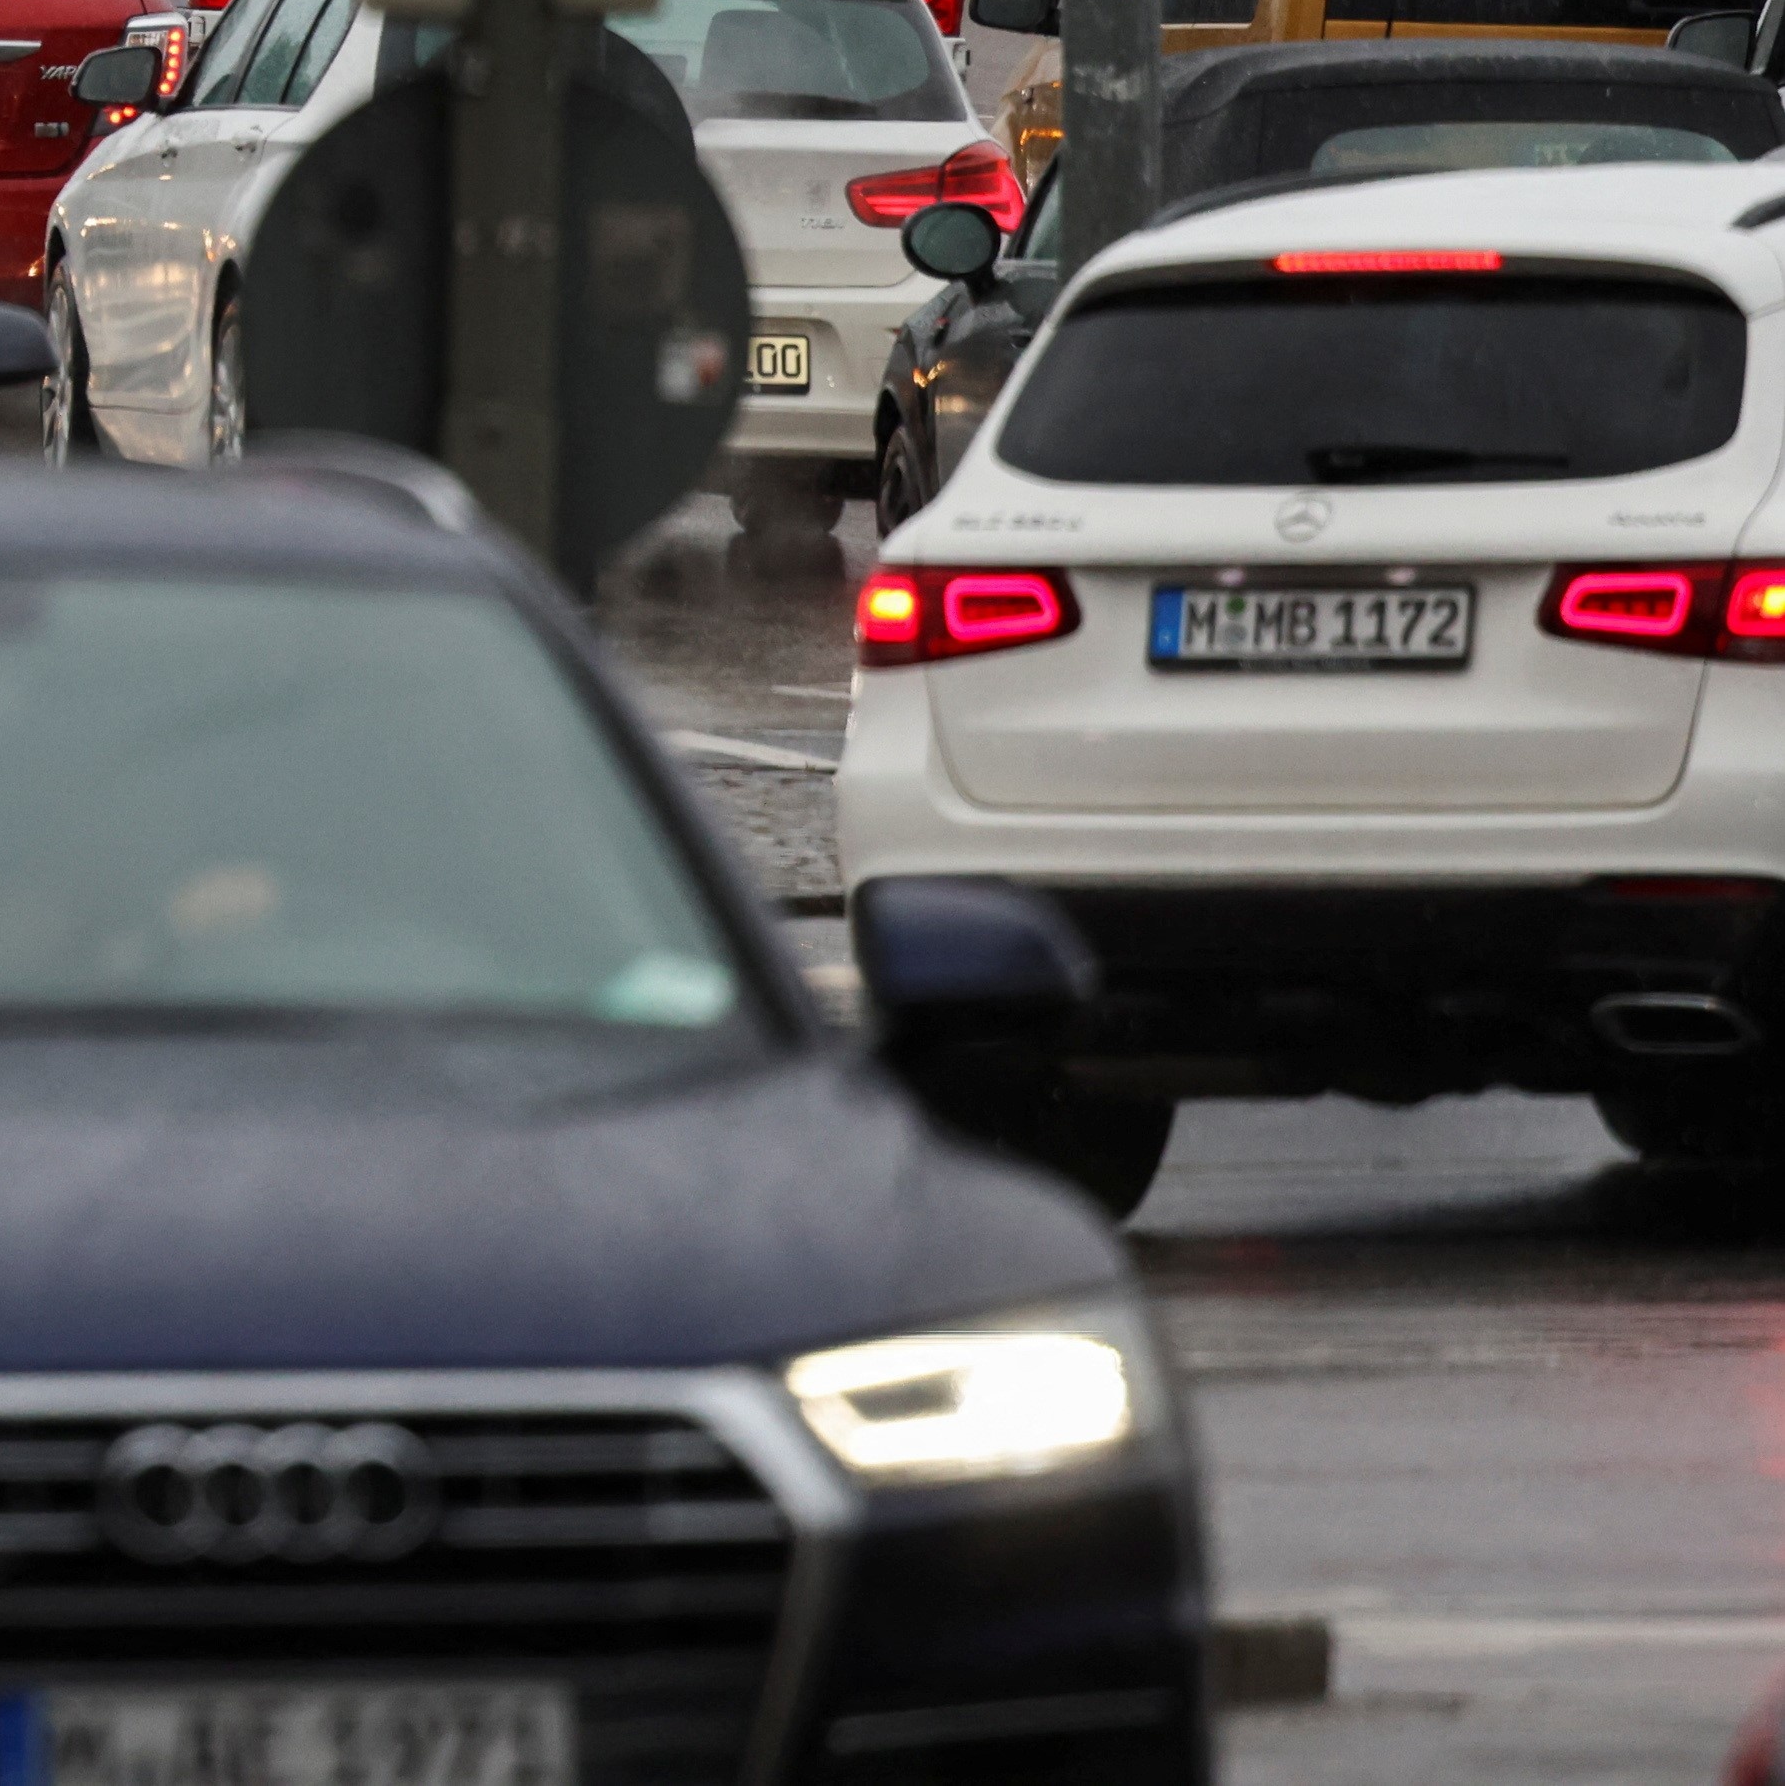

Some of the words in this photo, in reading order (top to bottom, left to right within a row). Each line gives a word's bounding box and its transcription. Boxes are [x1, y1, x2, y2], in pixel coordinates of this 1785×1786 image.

[39, 65, 78, 80] YAR
[748, 343, 802, 379] 00
[1186, 600, 1217, 647] M
[1330, 596, 1459, 647] 1172
